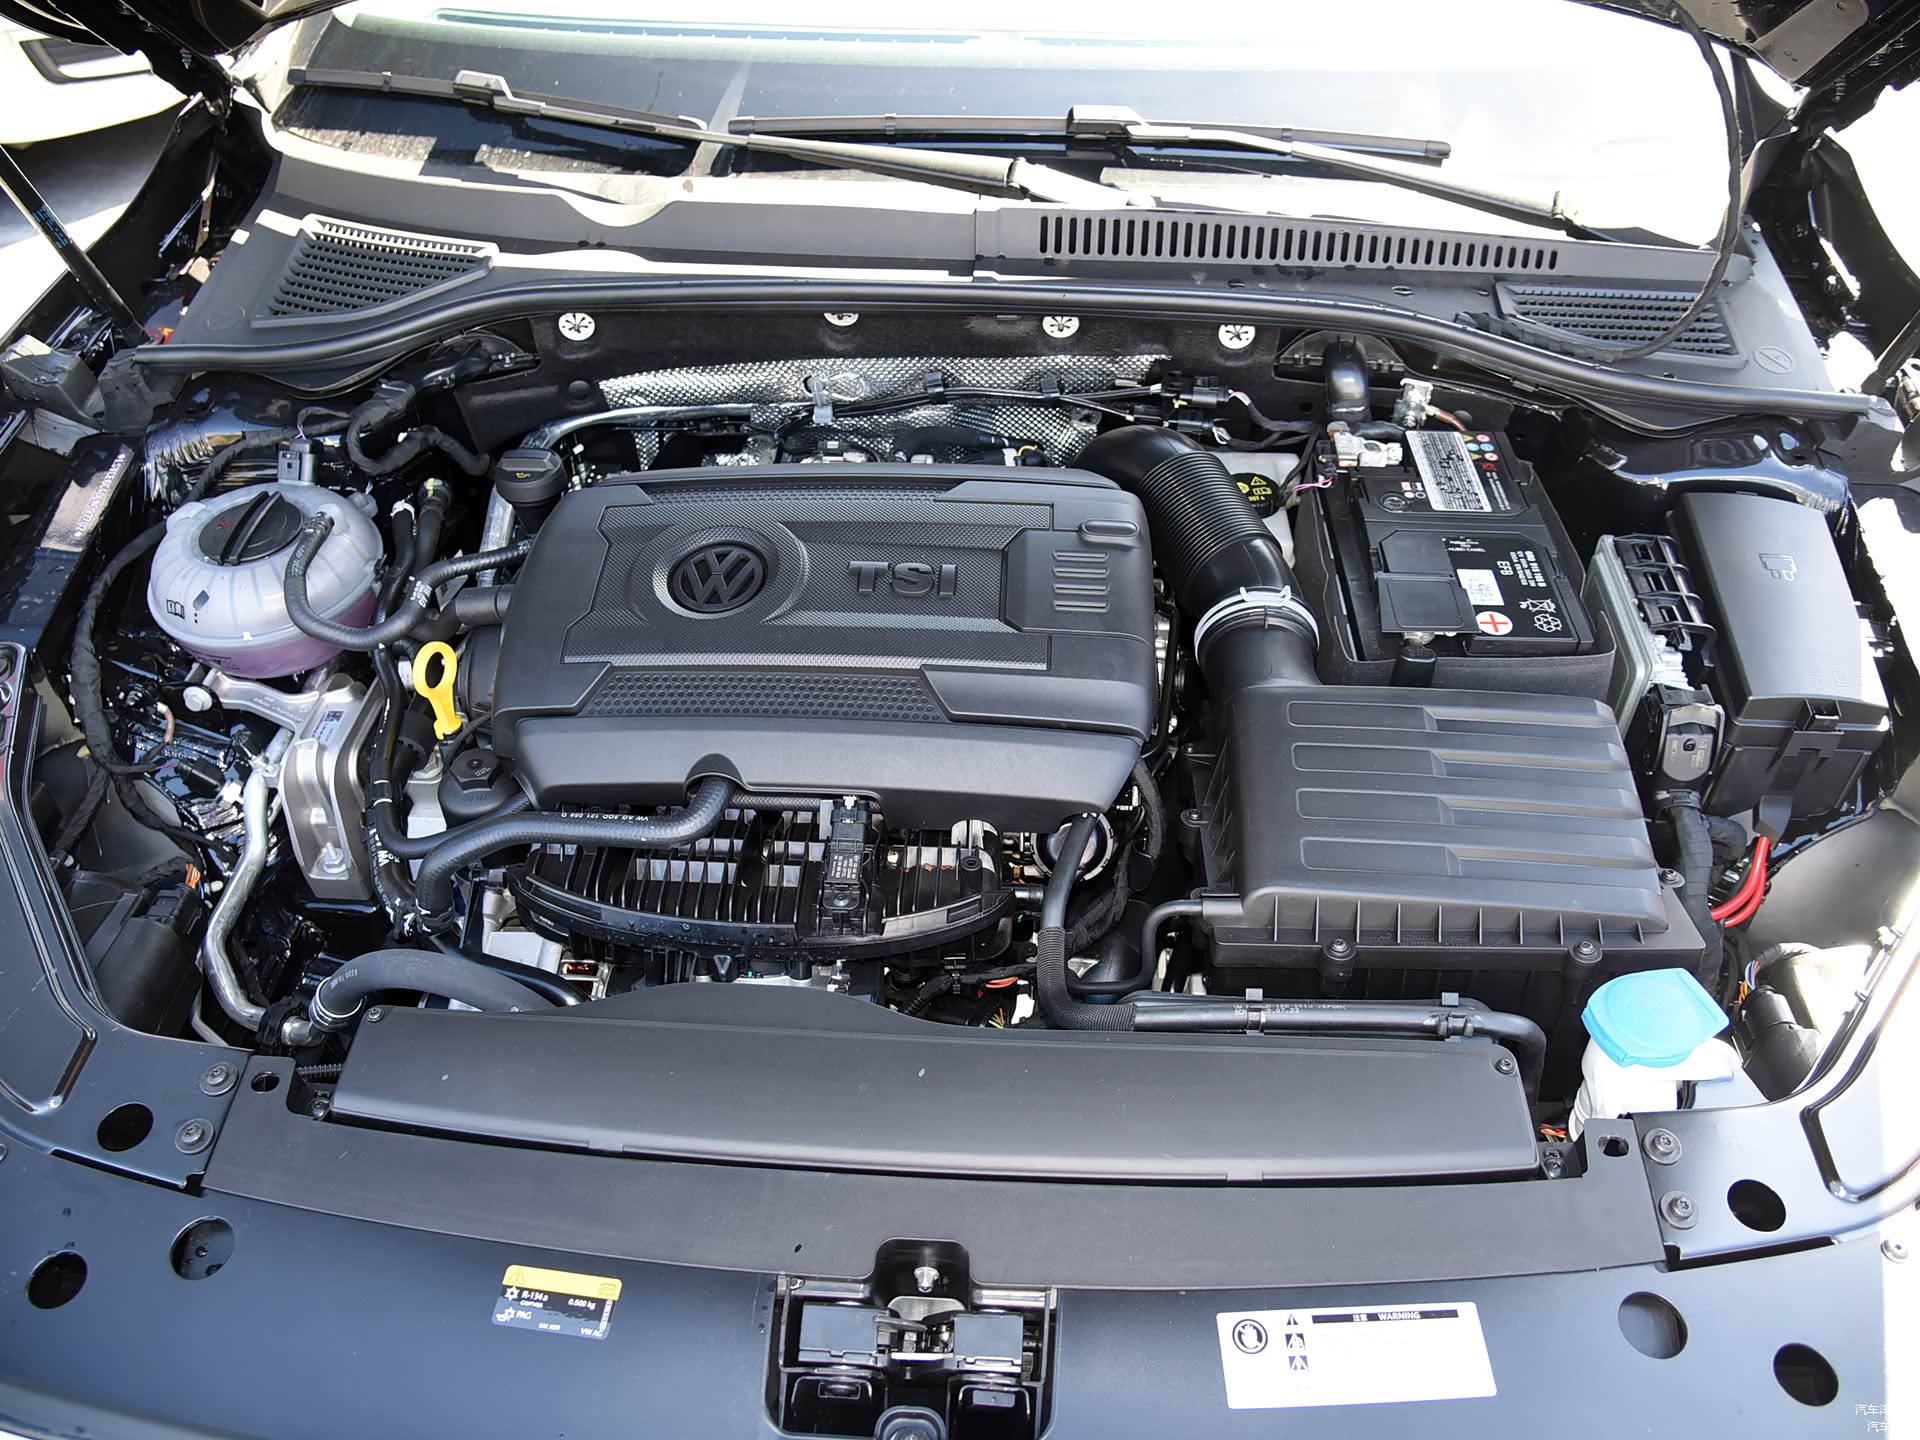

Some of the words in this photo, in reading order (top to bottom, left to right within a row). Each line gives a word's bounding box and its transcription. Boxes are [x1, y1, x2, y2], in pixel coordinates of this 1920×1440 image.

[1497, 560, 1513, 575] EFB
[848, 559, 957, 598] TSI
[587, 1300, 597, 1310] kg
[515, 1309, 532, 1320] PAG
[1378, 1311, 1421, 1321] WARNING
[580, 1327, 592, 1336] VW
